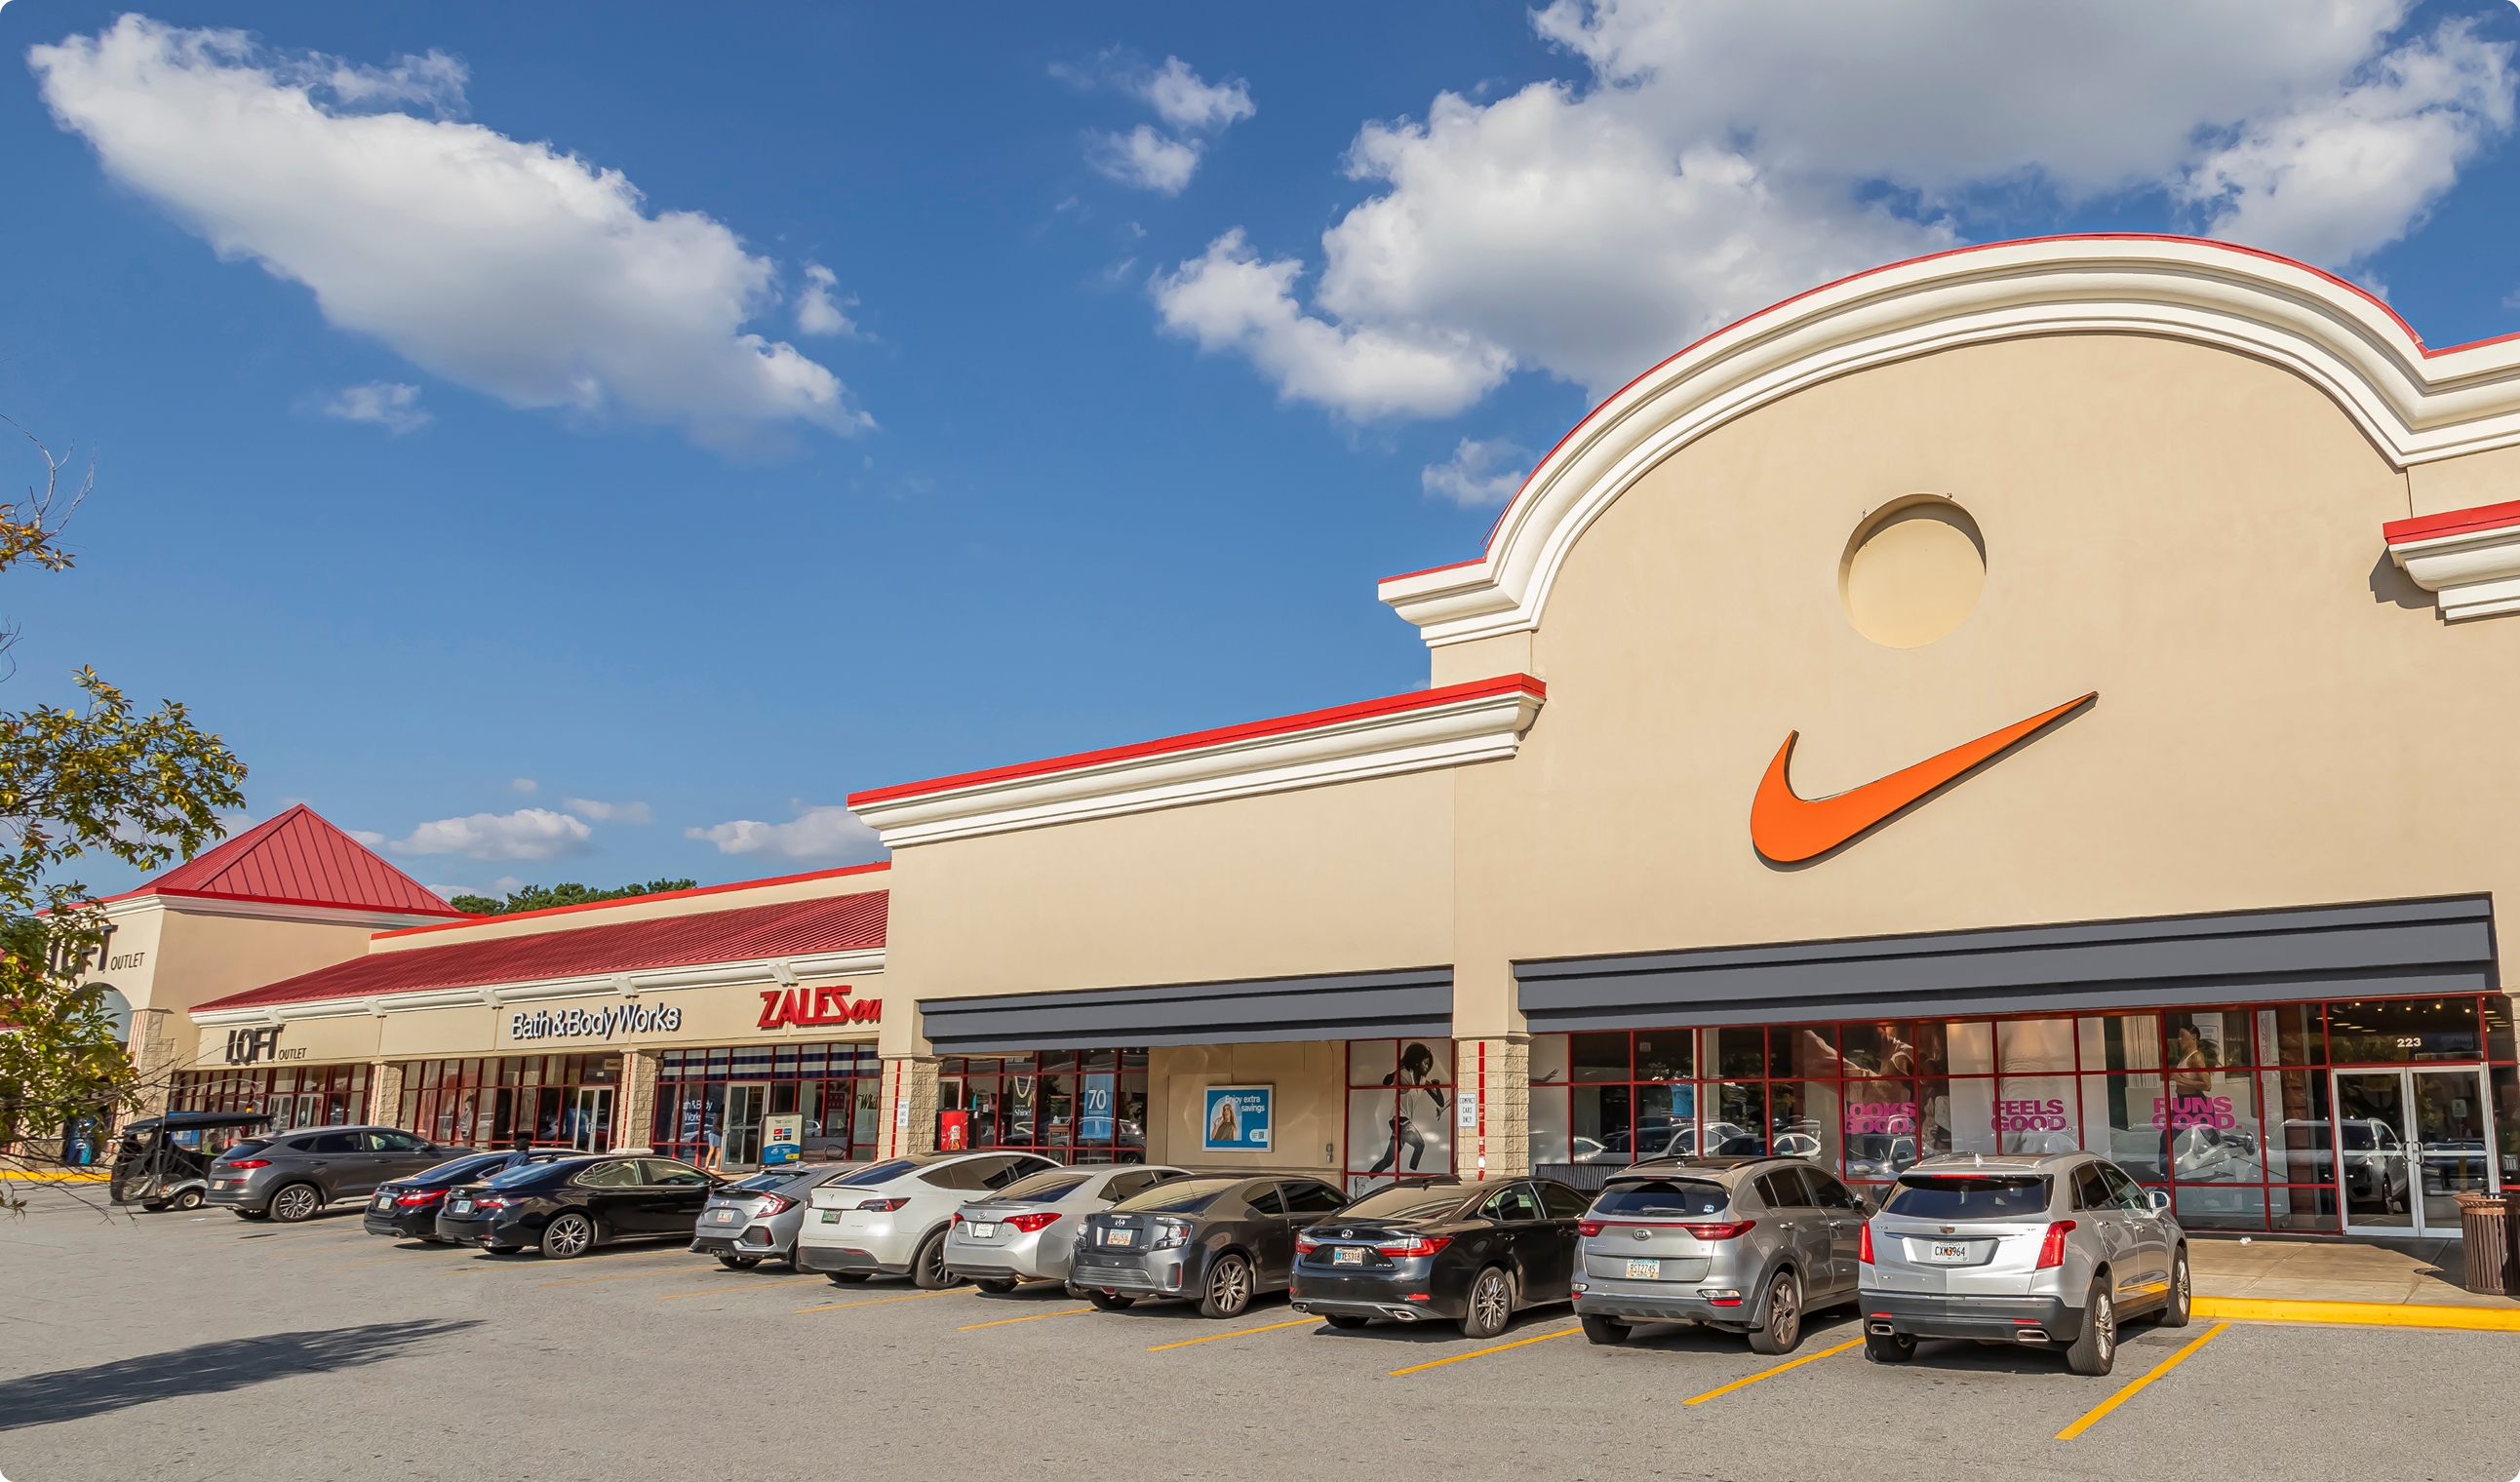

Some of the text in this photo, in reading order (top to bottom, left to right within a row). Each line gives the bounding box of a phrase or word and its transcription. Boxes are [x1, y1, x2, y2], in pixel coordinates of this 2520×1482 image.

[110, 952, 145, 971] OUTLET
[757, 985, 852, 1028] ZALES
[511, 1002, 681, 1039] Bath & Body Works
[225, 1024, 307, 1064] LOFT OUTLET
[2397, 1037, 2422, 1047] 223
[1088, 1089, 1107, 1110] 70
[1225, 1095, 1242, 1104] Enjoy
[1992, 1099, 2065, 1115] FEELS
[2153, 1096, 2232, 1112] RUNS
[1240, 1104, 1265, 1113] savings
[1846, 1102, 1915, 1118] OOKS
[1991, 1115, 2072, 1131] GOOD.
